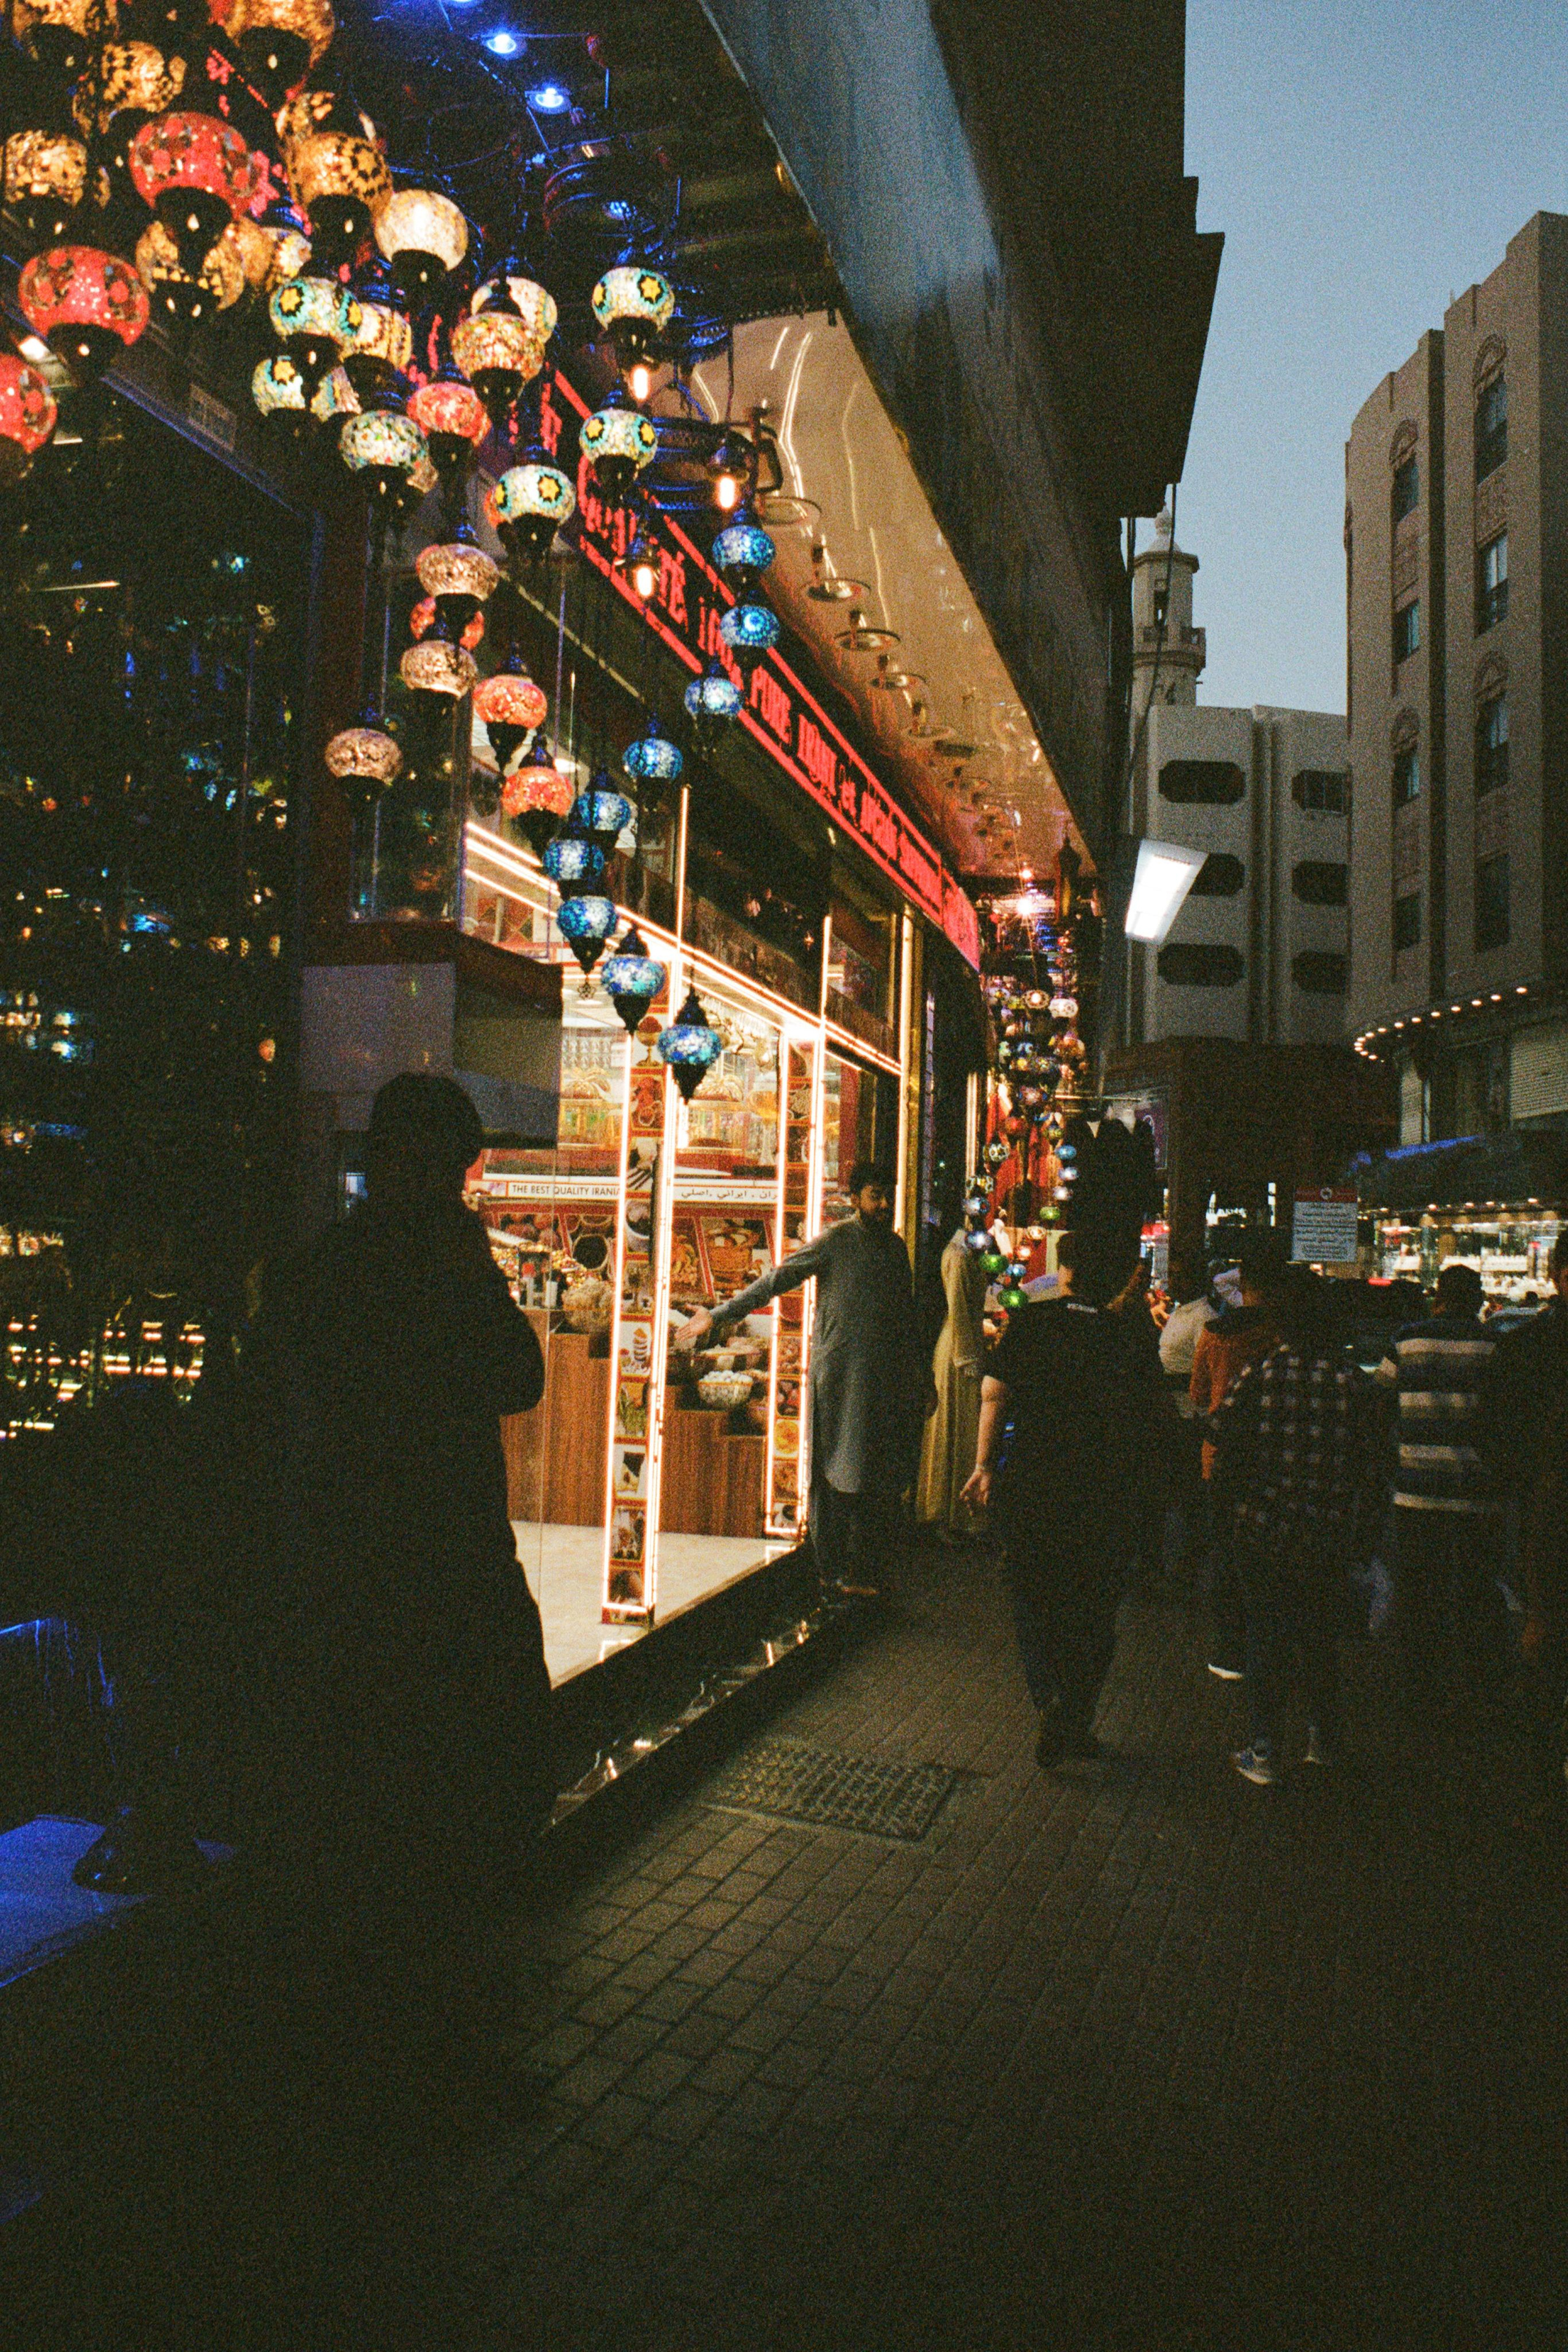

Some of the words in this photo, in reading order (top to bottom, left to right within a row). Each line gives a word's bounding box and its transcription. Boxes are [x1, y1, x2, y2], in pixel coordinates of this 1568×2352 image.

[512, 1184, 528, 1193] THE
[531, 1185, 550, 1194] BEST
[554, 1186, 589, 1196] QUALITY
